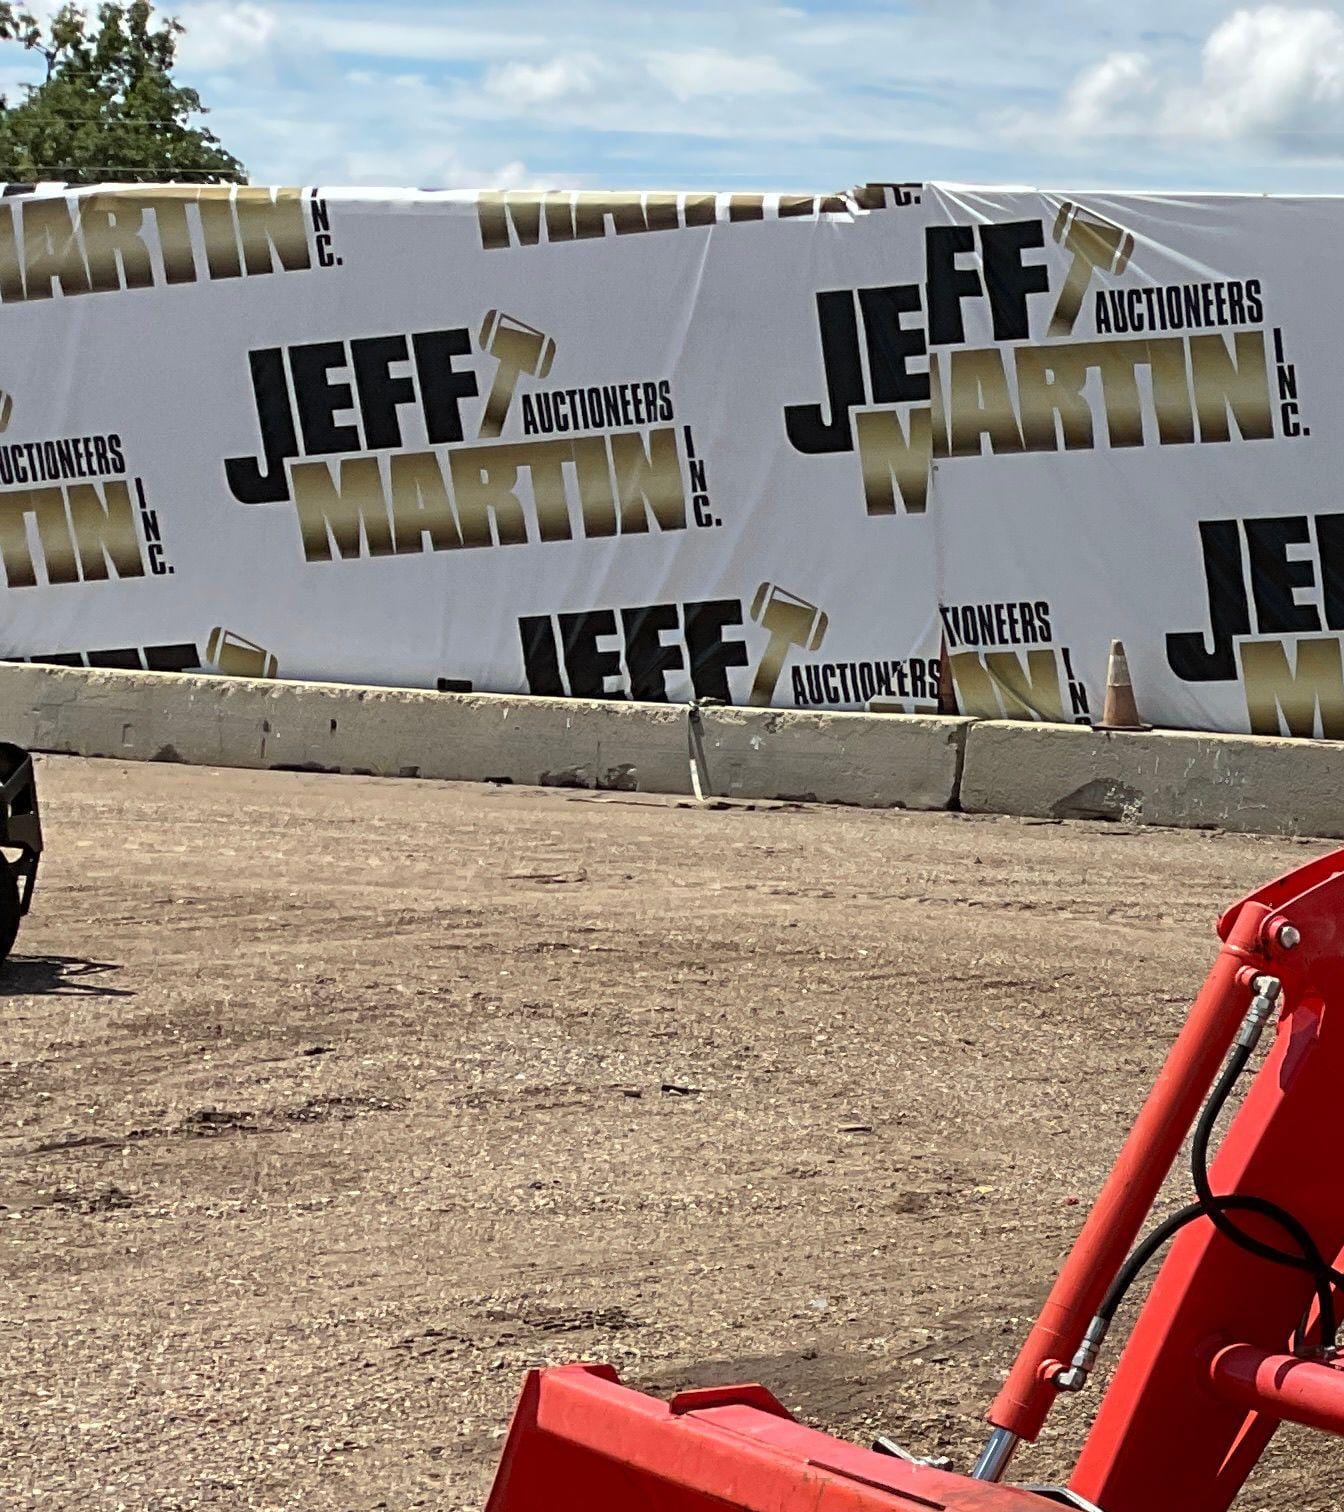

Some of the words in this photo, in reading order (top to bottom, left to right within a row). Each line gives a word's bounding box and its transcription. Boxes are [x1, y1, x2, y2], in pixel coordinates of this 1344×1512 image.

[0, 187, 312, 304] ARTIN
[784, 219, 1049, 455] JEFF
[1096, 279, 1263, 334] AUCTIONEERS
[224, 328, 478, 505] JEFF
[522, 380, 674, 435] AUCTIONEERS
[857, 330, 1274, 516] MARTIN
[1273, 327, 1310, 437] INC.
[0, 433, 126, 485] UCTIONEERS
[290, 428, 687, 562] MARTIN
[685, 426, 722, 528] INC.
[135, 477, 175, 575] INC.
